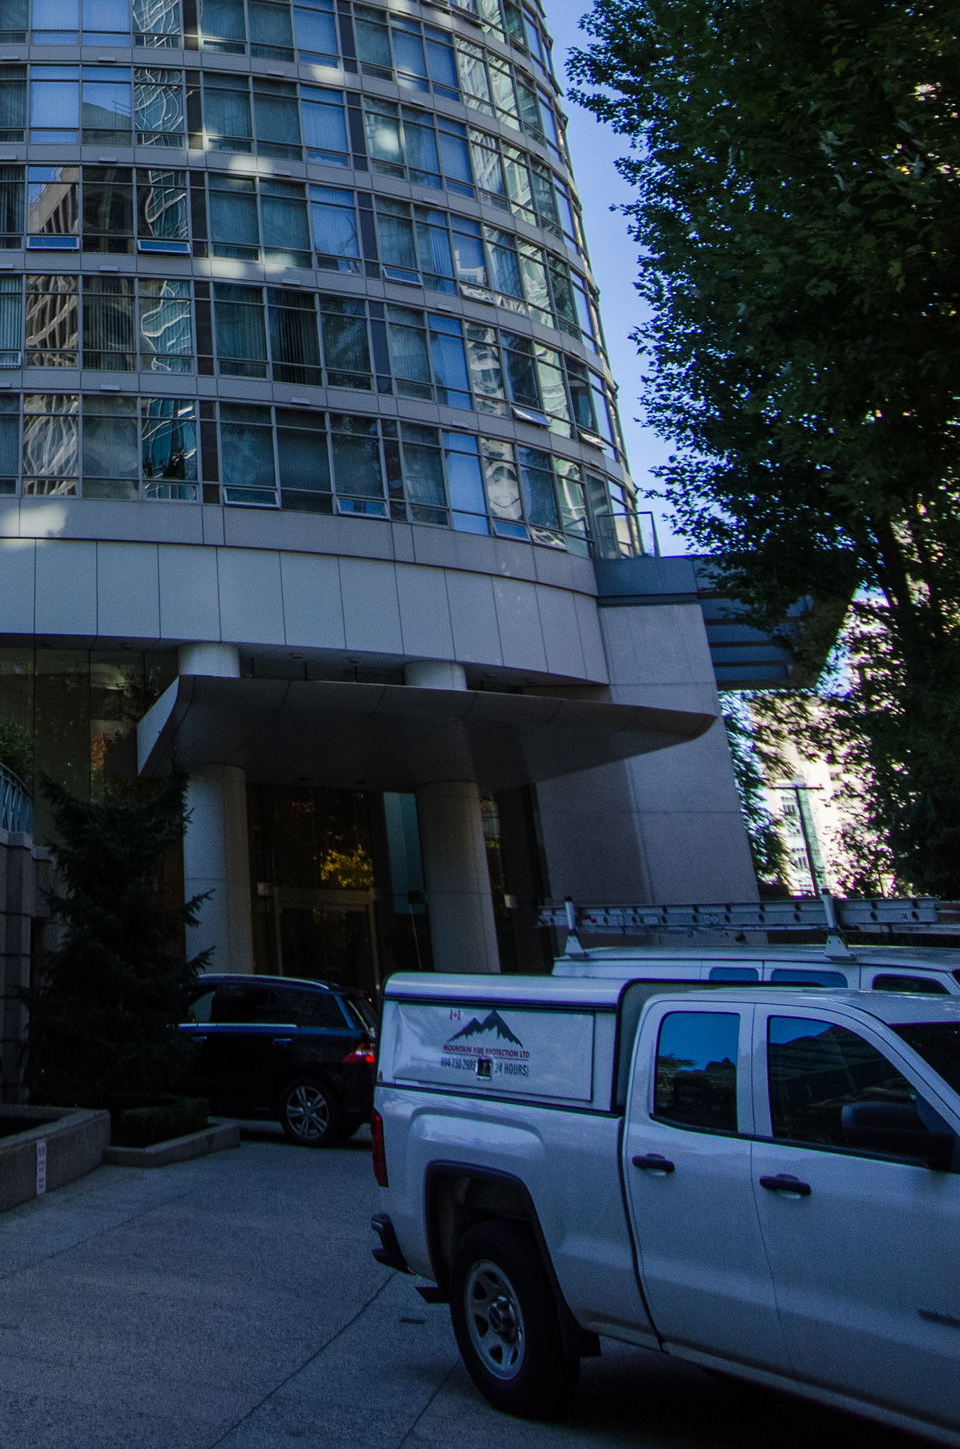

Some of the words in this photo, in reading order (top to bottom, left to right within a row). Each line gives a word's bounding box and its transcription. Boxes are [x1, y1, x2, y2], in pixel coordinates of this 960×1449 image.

[443, 1044, 472, 1053] MOUNTAIN
[473, 1046, 484, 1055] FIRE
[486, 1047, 519, 1058] PROTECTION
[519, 1050, 530, 1059] LTD
